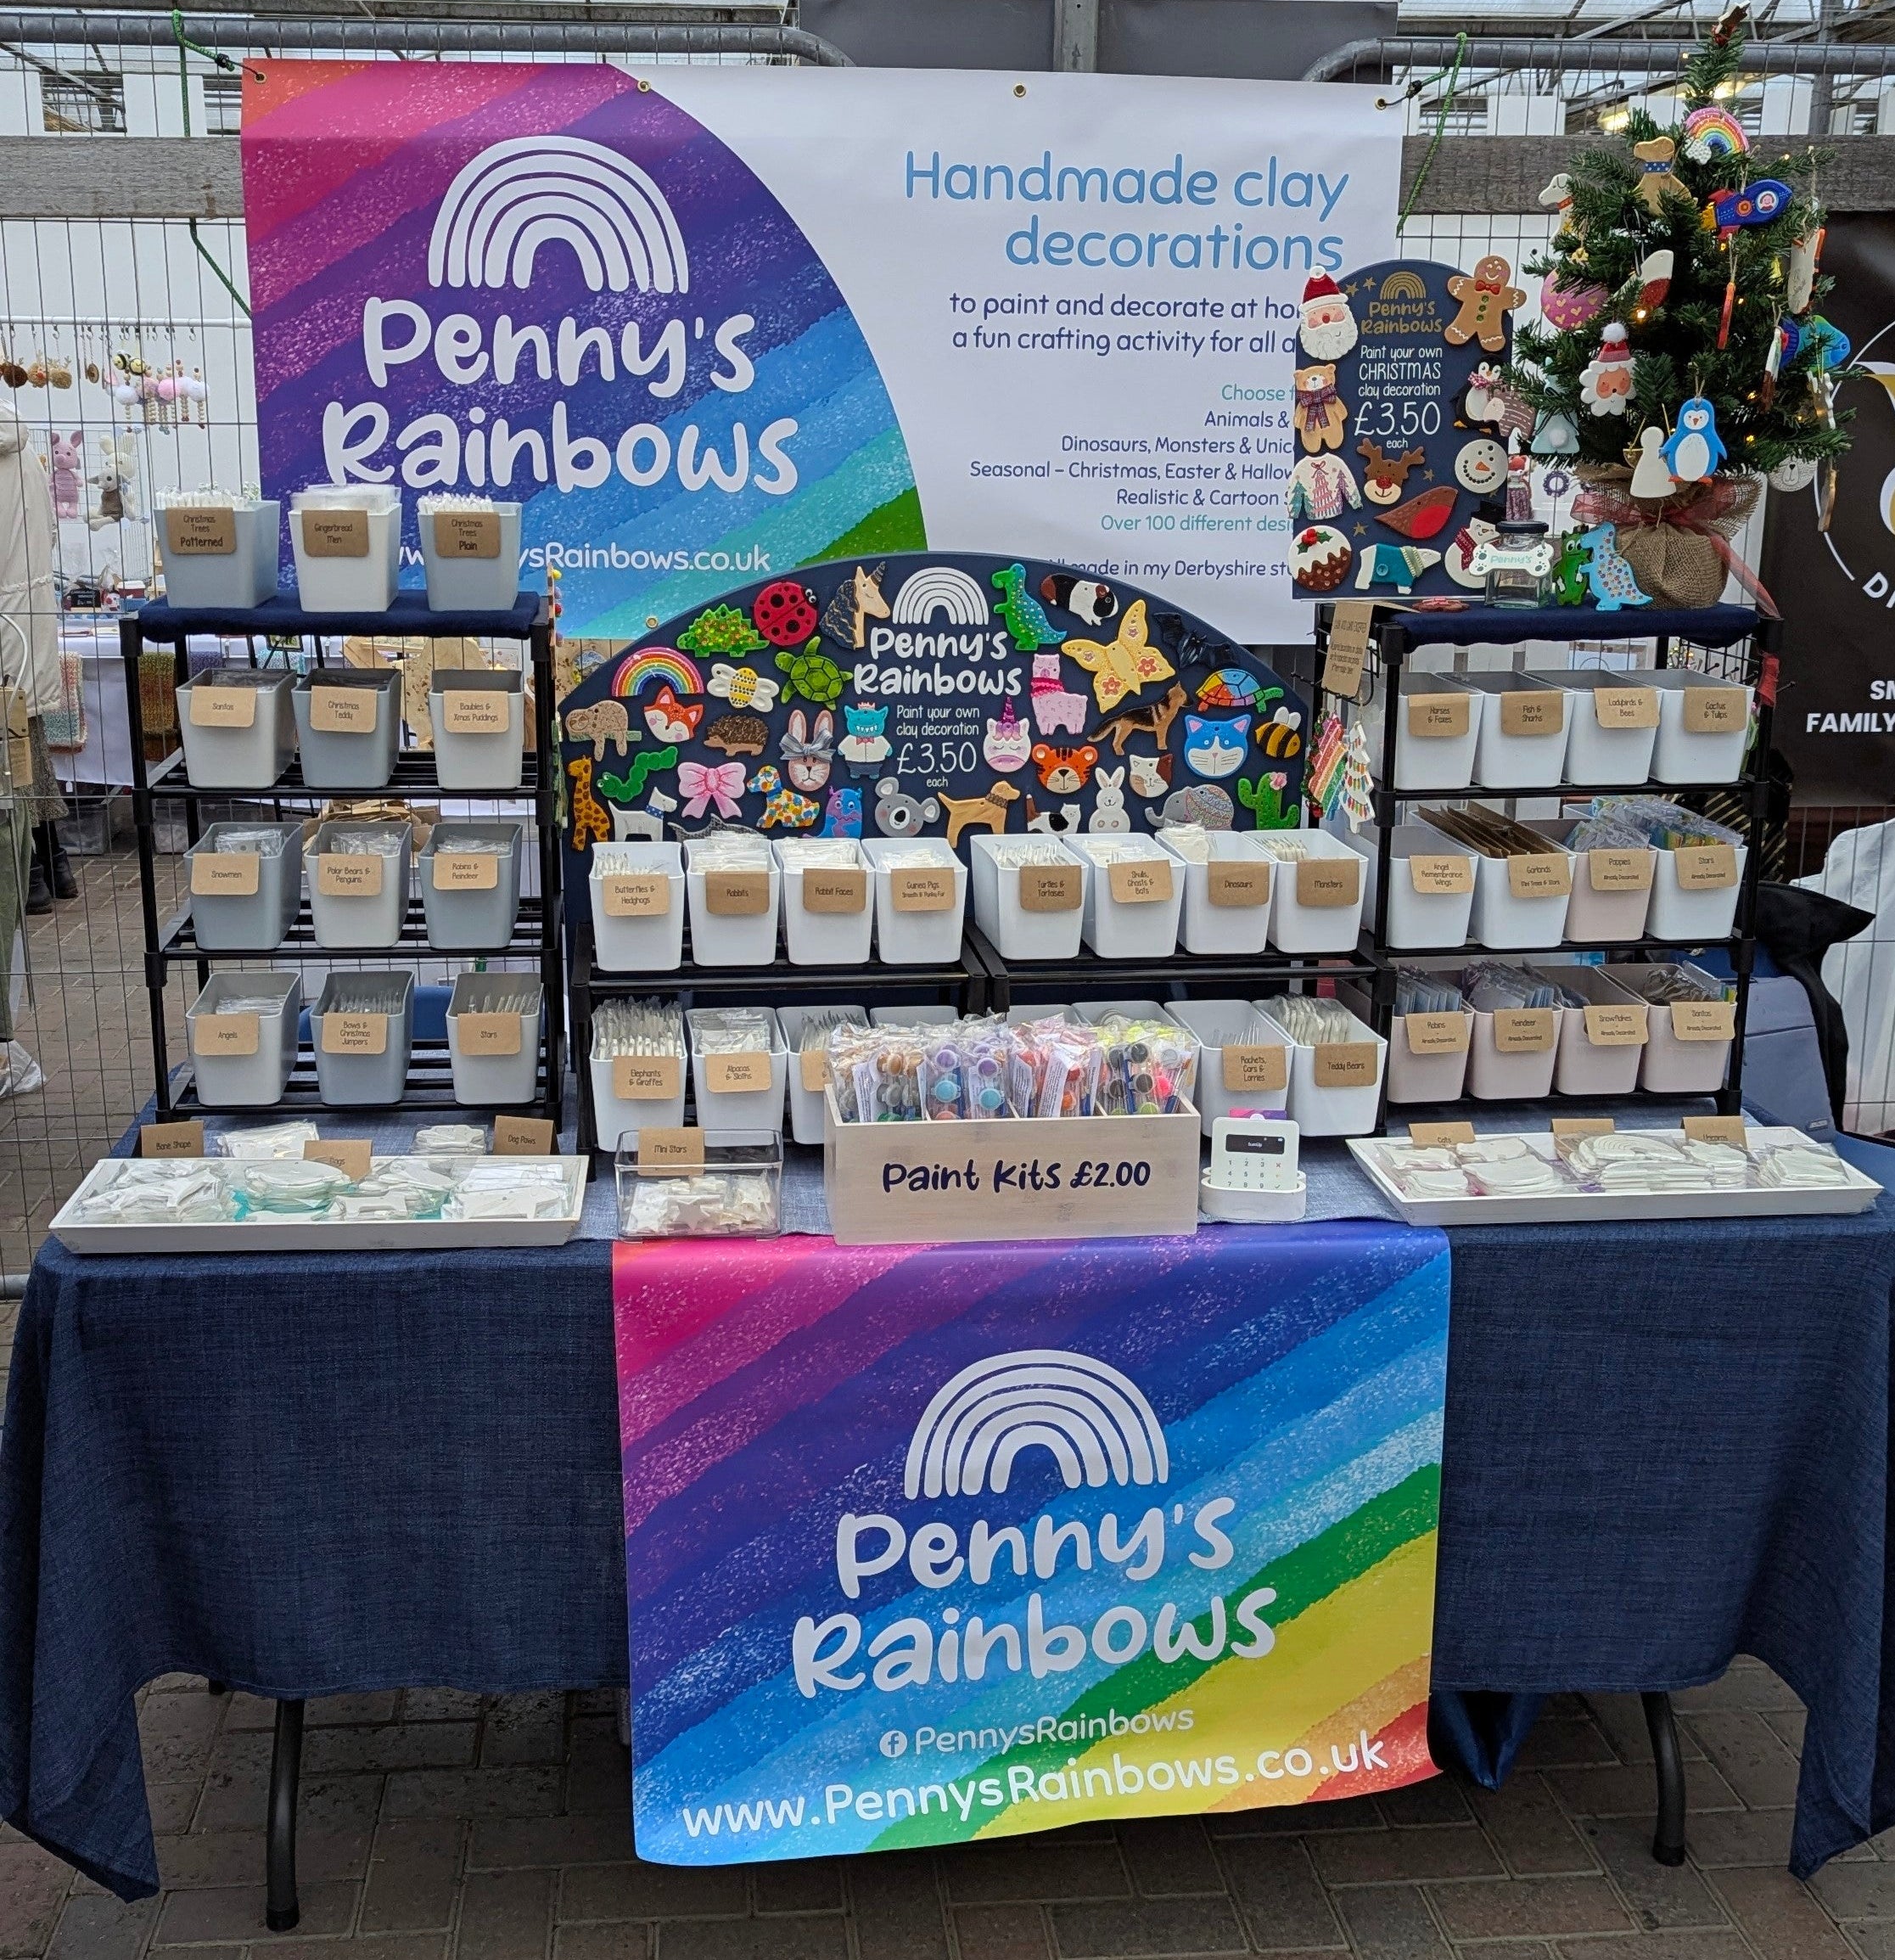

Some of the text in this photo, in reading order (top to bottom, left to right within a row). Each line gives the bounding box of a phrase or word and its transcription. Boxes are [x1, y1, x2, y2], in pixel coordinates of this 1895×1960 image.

[905, 150, 1349, 222] Handmade clay
[1006, 215, 1343, 271] decorations
[950, 293, 976, 314] to
[984, 293, 1049, 320] paint
[1056, 294, 1104, 316] and
[1111, 294, 1224, 318] decorate
[1231, 299, 1259, 319] at
[1369, 301, 1435, 317] Penny's
[1361, 318, 1443, 334] Rainbows
[363, 296, 755, 399] Penny's
[952, 326, 1275, 357] a fun crafting activity for all
[1360, 345, 1443, 362] Paint your own
[1360, 362, 1441, 380] CHRISTMAS
[1222, 384, 1286, 402] Choose
[1359, 383, 1440, 400] clay decoration
[1204, 411, 1290, 428] Animals &
[1354, 402, 1441, 435] £3.50
[322, 401, 799, 495] Rainbows
[1062, 436, 1295, 455] Dinosaurs, Monsters & Unic
[1387, 439, 1408, 448] each
[970, 461, 1236, 480] Seasonal Christmas, Easter &
[1117, 488, 1189, 505] Realistic
[1193, 489, 1205, 505] &
[1210, 490, 1279, 505] Cartoon
[1101, 514, 1253, 531] Over 100 different
[181, 536, 223, 548] Patterned
[327, 535, 342, 544] Men
[458, 541, 478, 551] Plain
[1124, 560, 1266, 580] in my Derbyshire
[871, 626, 1008, 662] Penny's
[854, 663, 1023, 696] Rainbows
[897, 705, 980, 722] Paint your own
[1620, 709, 1634, 717] Bees
[896, 723, 979, 739] clay decoration
[897, 742, 976, 774] £3.50
[927, 777, 948, 788] each
[1609, 857, 1631, 866] Poppies
[344, 868, 362, 876] Bears
[1314, 879, 1343, 889] Monsters
[883, 1159, 1151, 1193] Paint Kits £2.00
[835, 1496, 1236, 1600] Penny's
[793, 1587, 1277, 1699] Rainbows
[915, 1707, 1195, 1759] PennysRainbows
[681, 1729, 1389, 1839] www.PennysRainbows.co.uk
